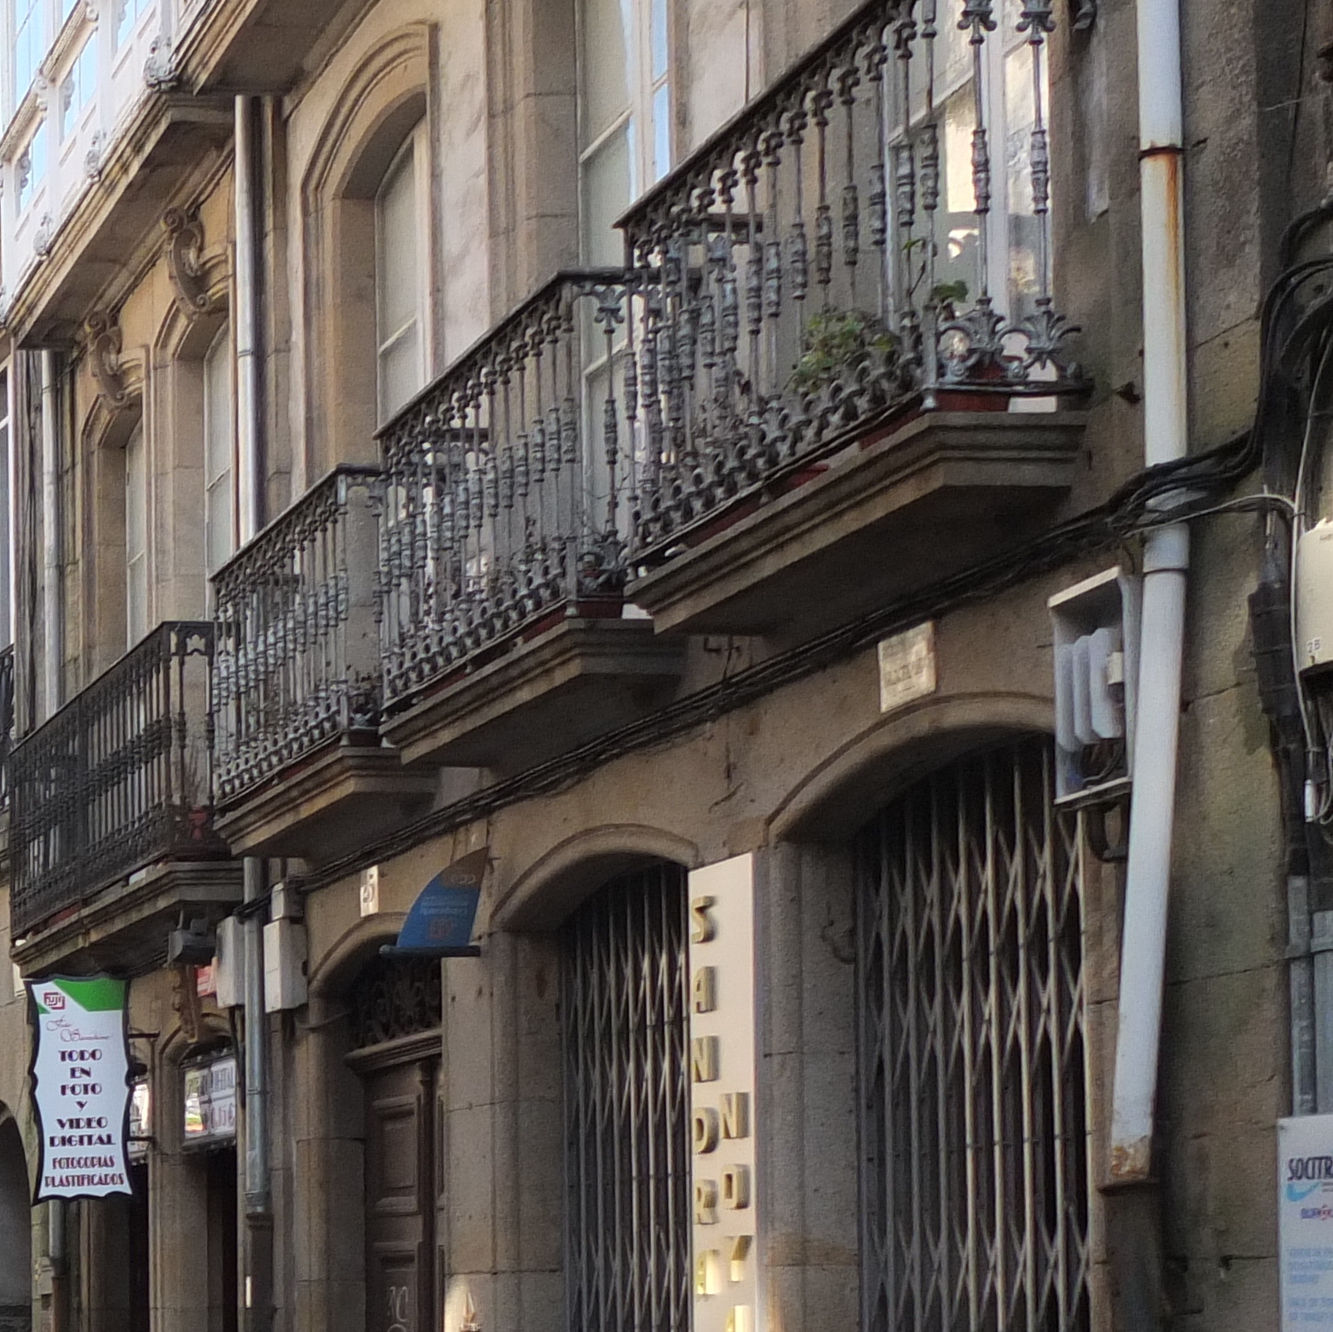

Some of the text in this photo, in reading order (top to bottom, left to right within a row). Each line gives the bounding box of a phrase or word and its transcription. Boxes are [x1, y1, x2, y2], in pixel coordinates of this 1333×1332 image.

[58, 1049, 103, 1062] TODO
[69, 1067, 91, 1079] EN
[60, 1083, 103, 1096] FOTO
[690, 894, 721, 1296] SANDRA
[56, 1117, 109, 1130] VIDEO
[49, 1134, 116, 1147] DIGITAL
[52, 1155, 115, 1170] FOTOCOPIAS
[44, 1173, 125, 1188] PLASTIFICADOS
